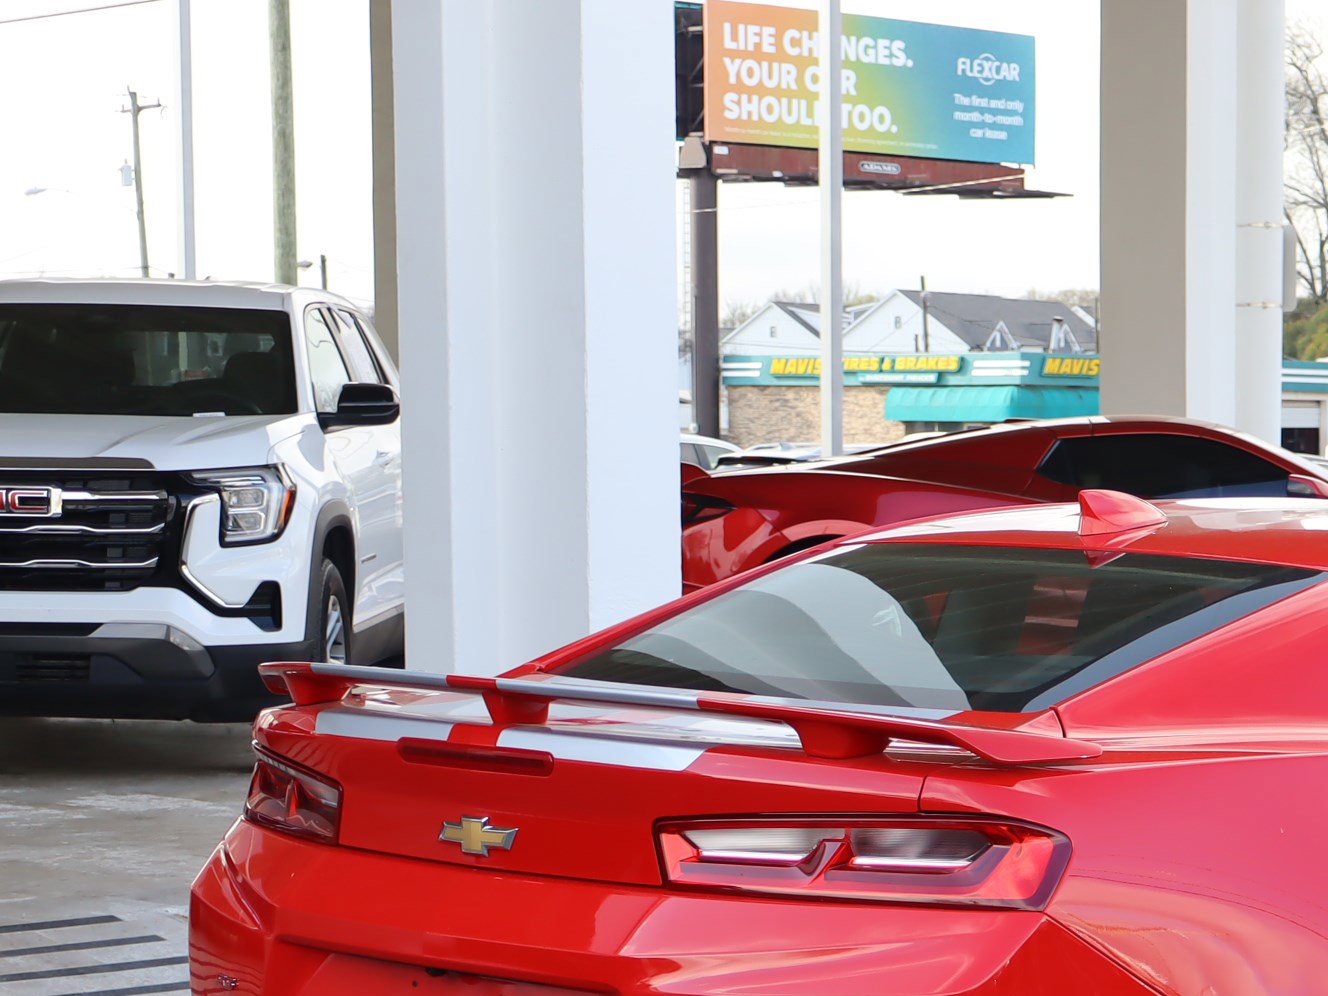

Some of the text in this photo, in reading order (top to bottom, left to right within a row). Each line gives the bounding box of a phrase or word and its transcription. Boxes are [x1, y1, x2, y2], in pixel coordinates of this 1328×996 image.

[723, 22, 914, 68] LIFE CHNGES.
[723, 57, 857, 96] YOUR CR
[957, 57, 1020, 82] FLEXCAR
[953, 93, 970, 106] The
[841, 103, 898, 134] TOO.
[895, 356, 960, 371] BRAKES
[1044, 357, 1100, 376] MAVIS
